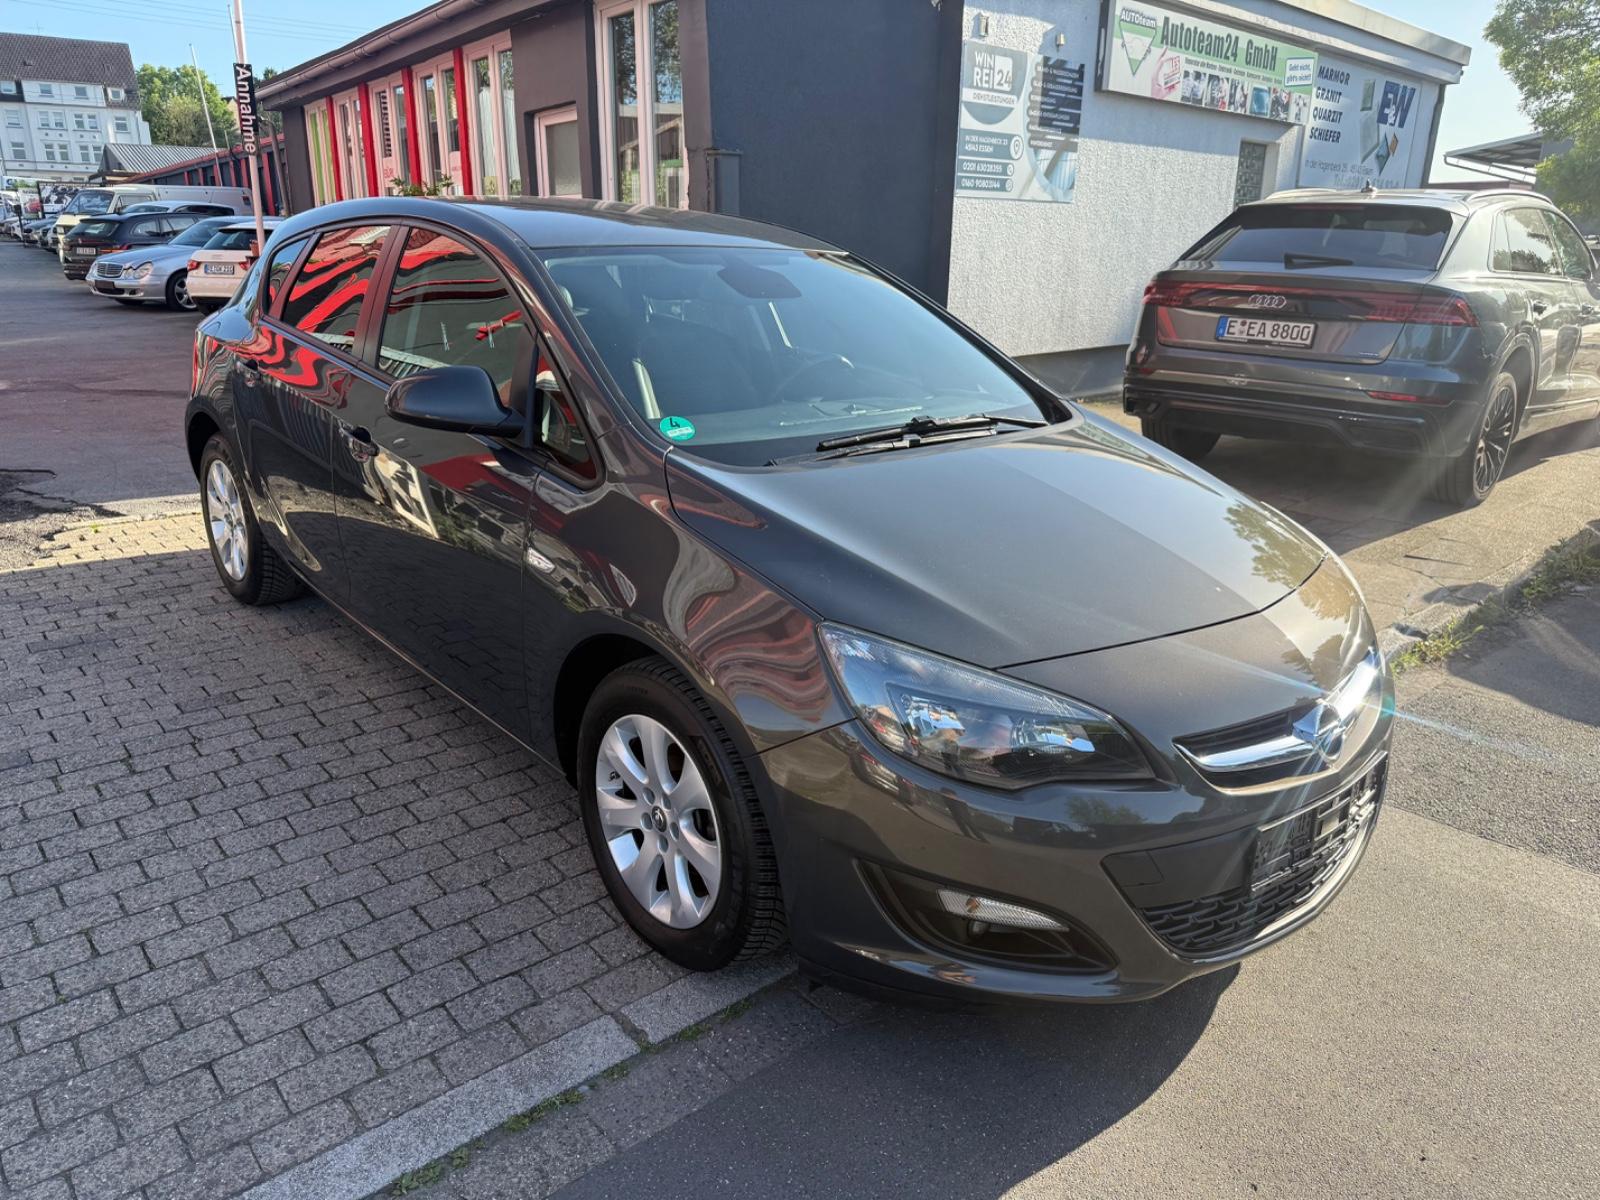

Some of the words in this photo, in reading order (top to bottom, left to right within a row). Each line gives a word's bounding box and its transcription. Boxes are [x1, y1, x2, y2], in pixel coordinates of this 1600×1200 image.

[1120, 8, 1157, 28] AUTOteam
[1160, 16, 1240, 62] Autoteam24
[1245, 39, 1278, 71] GmbH
[975, 51, 994, 68] WIN
[973, 67, 994, 89] REI
[996, 69, 1012, 88] 24
[1317, 66, 1350, 86] MARMOR
[1315, 86, 1342, 104] GRANIT
[236, 66, 256, 153] Annahme
[1312, 107, 1343, 124] QUARZIT
[1309, 127, 1341, 144] SCHIEFER
[1226, 319, 1237, 336] E
[1246, 321, 1266, 338] EA
[1270, 323, 1311, 342] 8800
